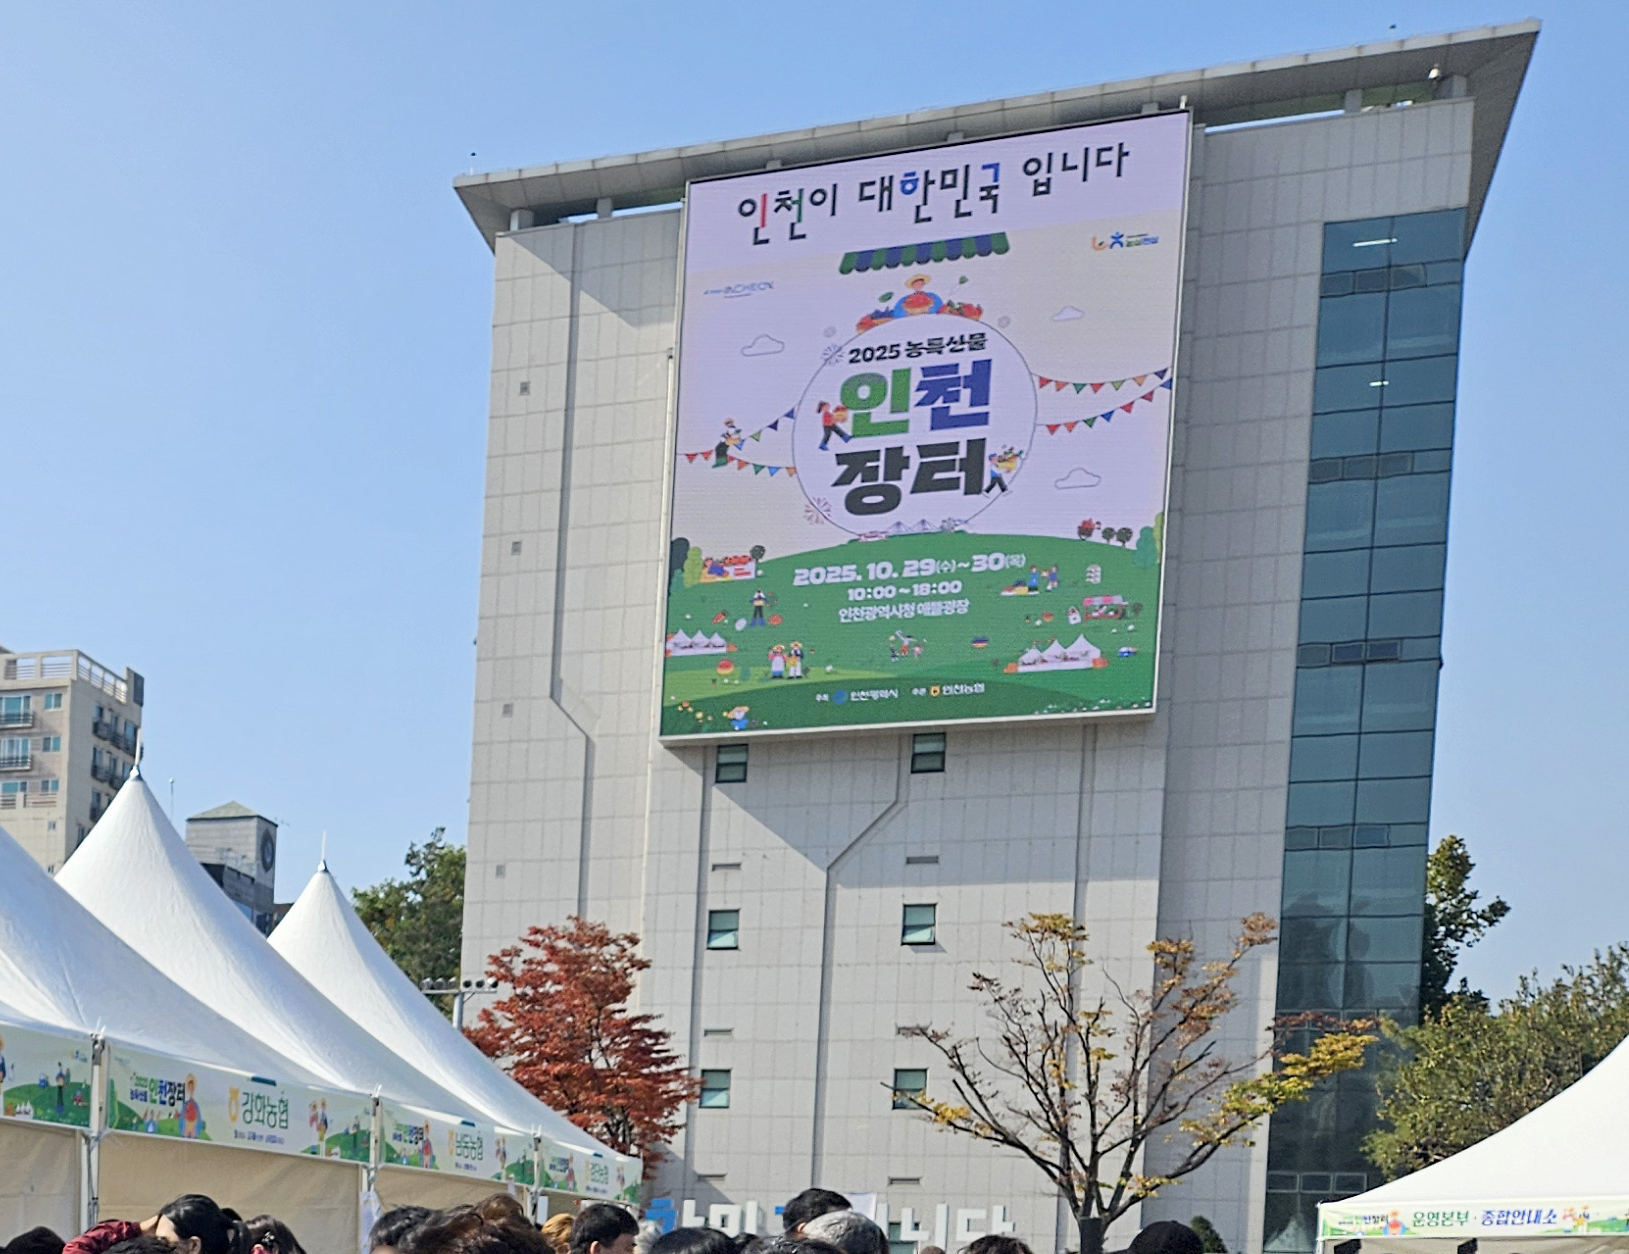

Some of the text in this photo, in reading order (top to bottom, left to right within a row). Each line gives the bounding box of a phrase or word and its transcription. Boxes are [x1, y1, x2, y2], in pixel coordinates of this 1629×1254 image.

[737, 142, 1130, 247] 인천이 대한민국 입니다
[849, 333, 988, 364] 2025 농특산물
[840, 359, 992, 437] 인천
[831, 438, 986, 516] 장터
[793, 565, 862, 586] 2025.
[866, 562, 898, 580] 10.
[242, 1092, 288, 1129] 강화농협
[1413, 1211, 1469, 1227] 운영본부
[1481, 1209, 1558, 1226] 종합안내소
